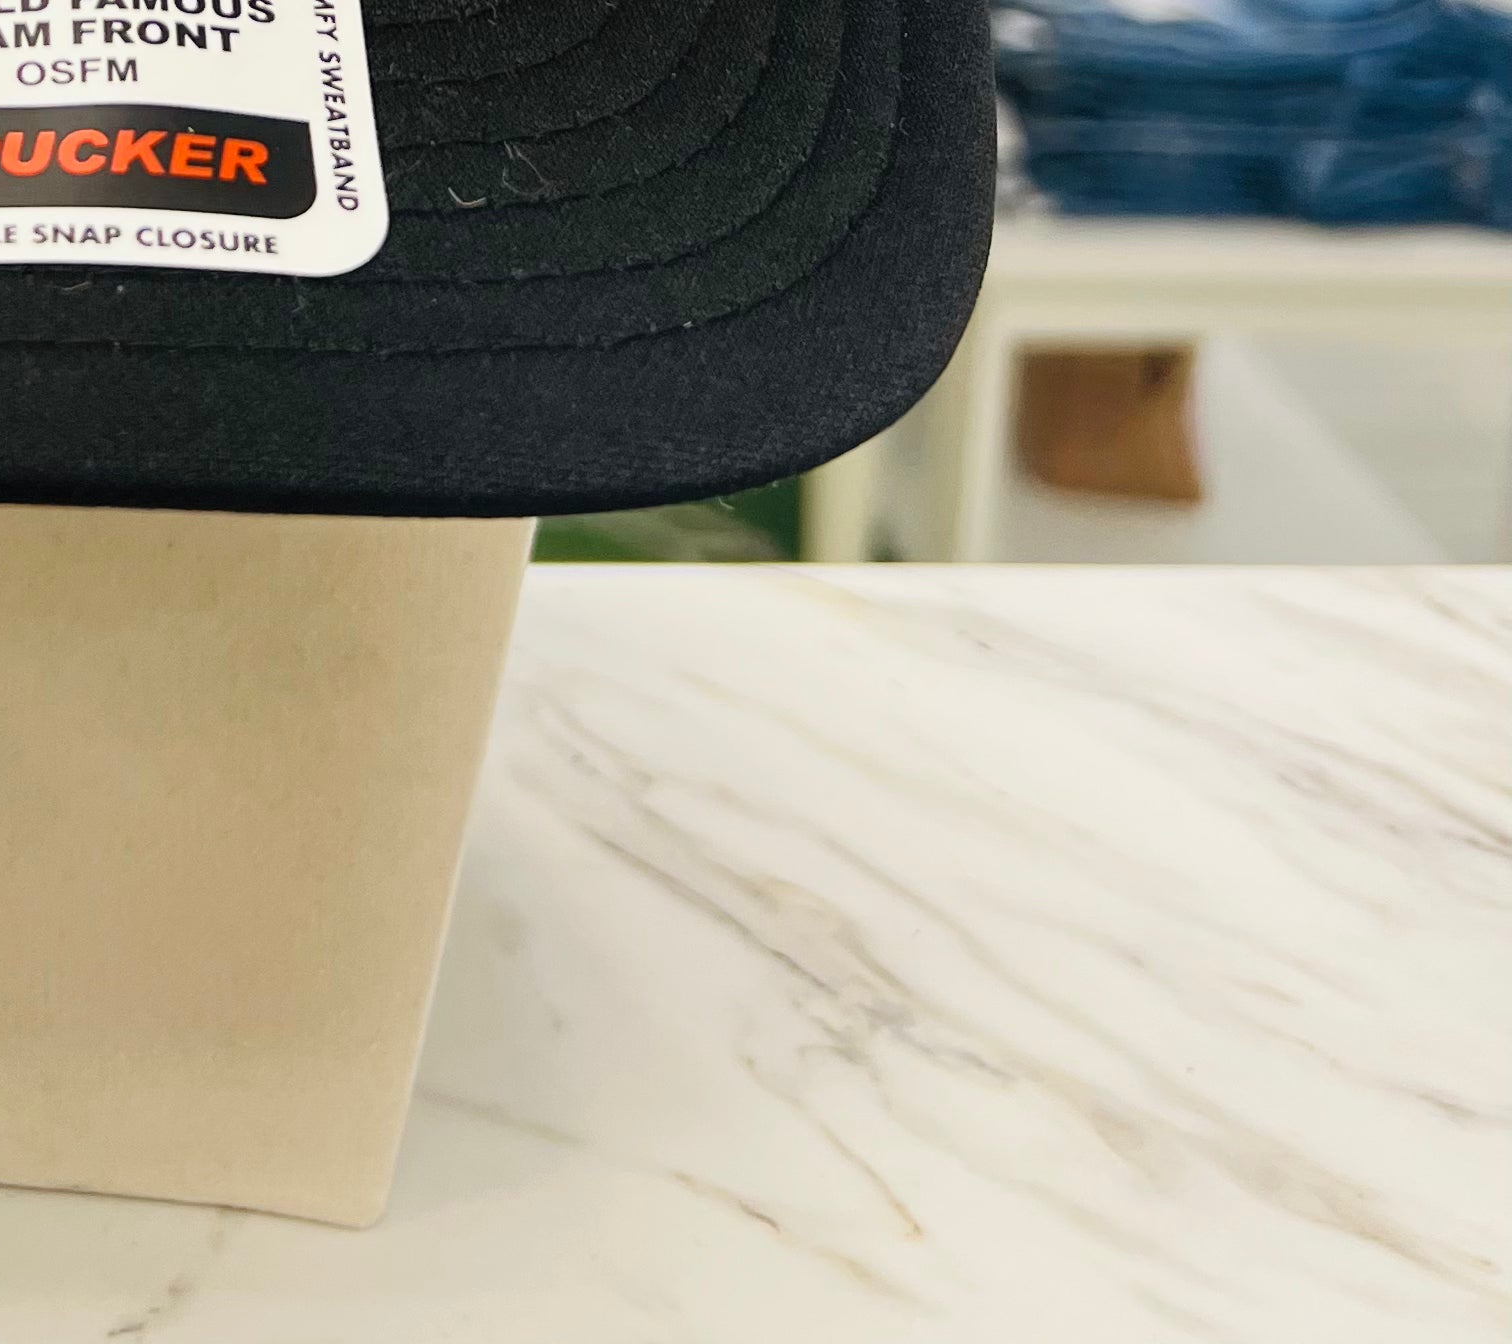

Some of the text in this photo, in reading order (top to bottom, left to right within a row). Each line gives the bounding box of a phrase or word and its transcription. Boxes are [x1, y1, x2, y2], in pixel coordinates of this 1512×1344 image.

[72, 19, 241, 53] FRONT
[16, 58, 138, 86] OSFM
[318, 51, 359, 211] SWEATBAND
[33, 225, 122, 246] SNAP
[136, 227, 277, 254] CLOSURE
